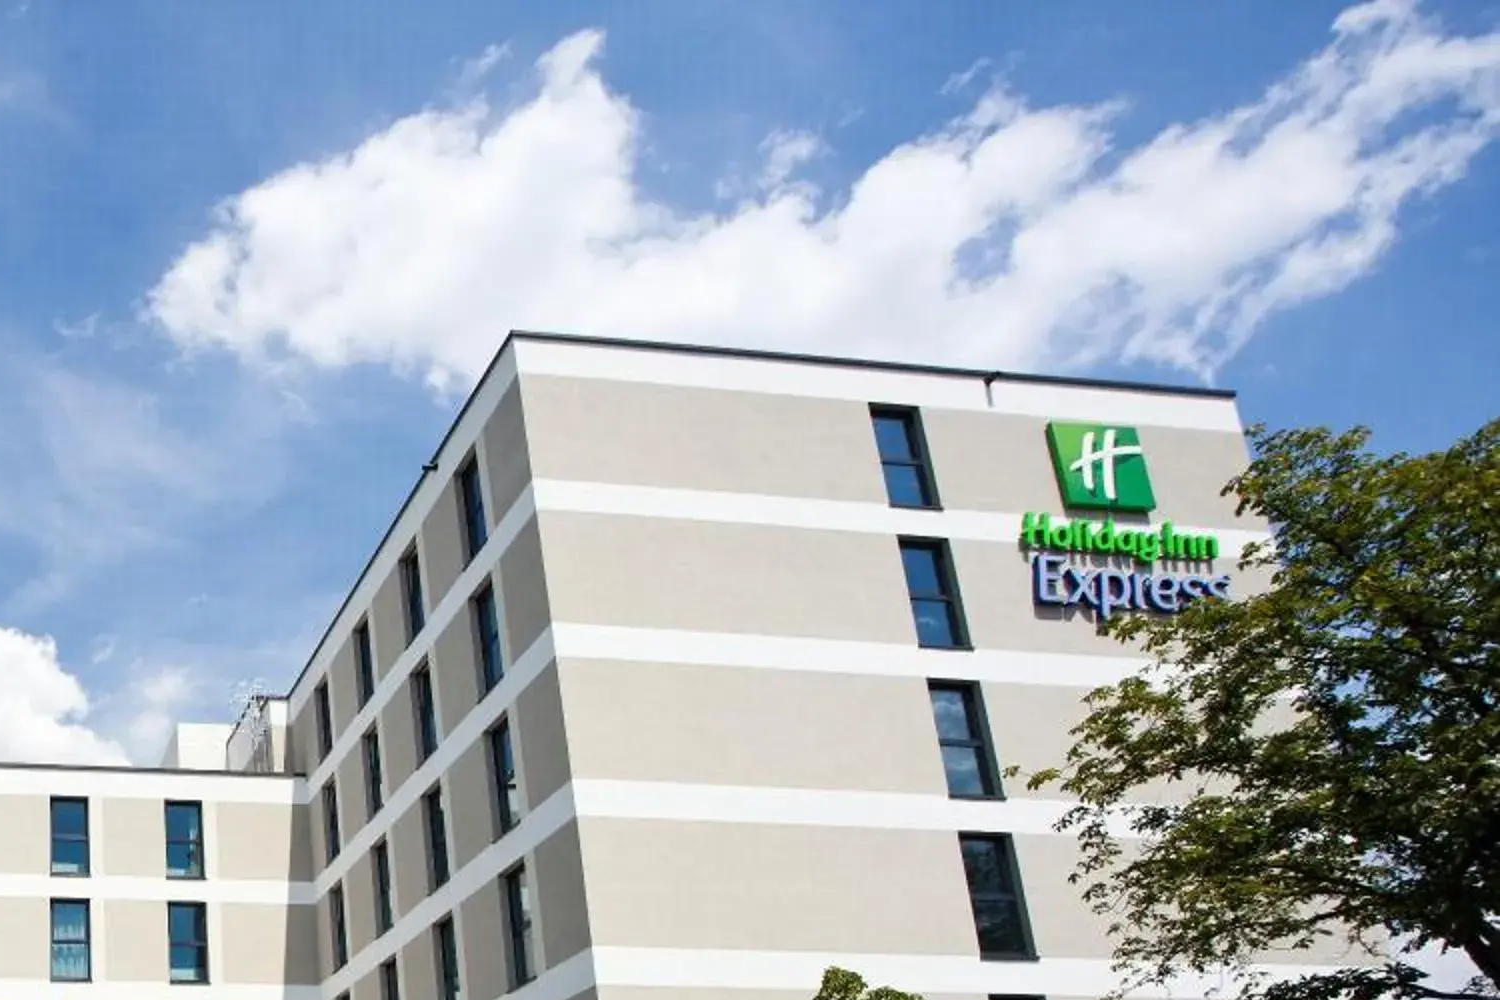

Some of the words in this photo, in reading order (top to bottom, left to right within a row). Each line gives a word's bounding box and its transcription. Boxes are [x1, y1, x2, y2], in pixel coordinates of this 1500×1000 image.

[1021, 511, 1160, 563] Holiday
[1160, 518, 1219, 561] Inn
[1032, 551, 1233, 622] Express
